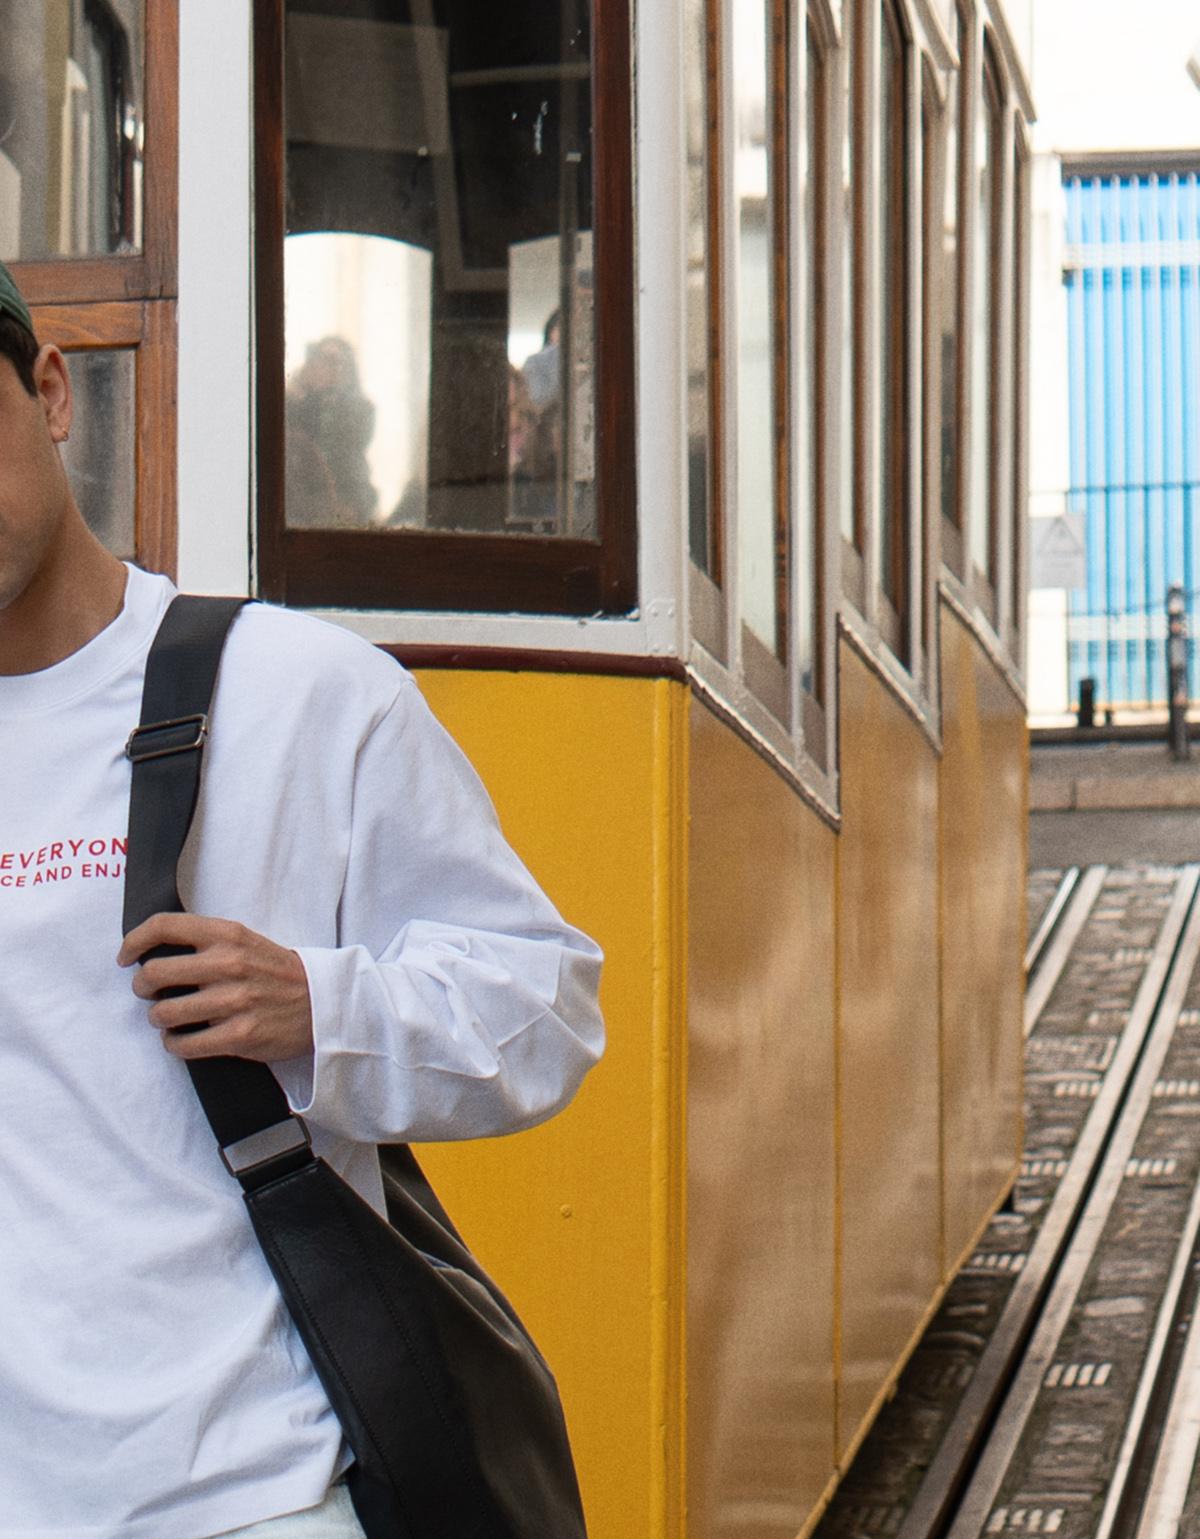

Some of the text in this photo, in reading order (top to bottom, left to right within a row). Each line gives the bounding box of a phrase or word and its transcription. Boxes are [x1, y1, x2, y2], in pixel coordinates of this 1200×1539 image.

[0, 837, 129, 869] EVERYON
[33, 866, 72, 886] AND
[81, 863, 127, 878] ENJ
